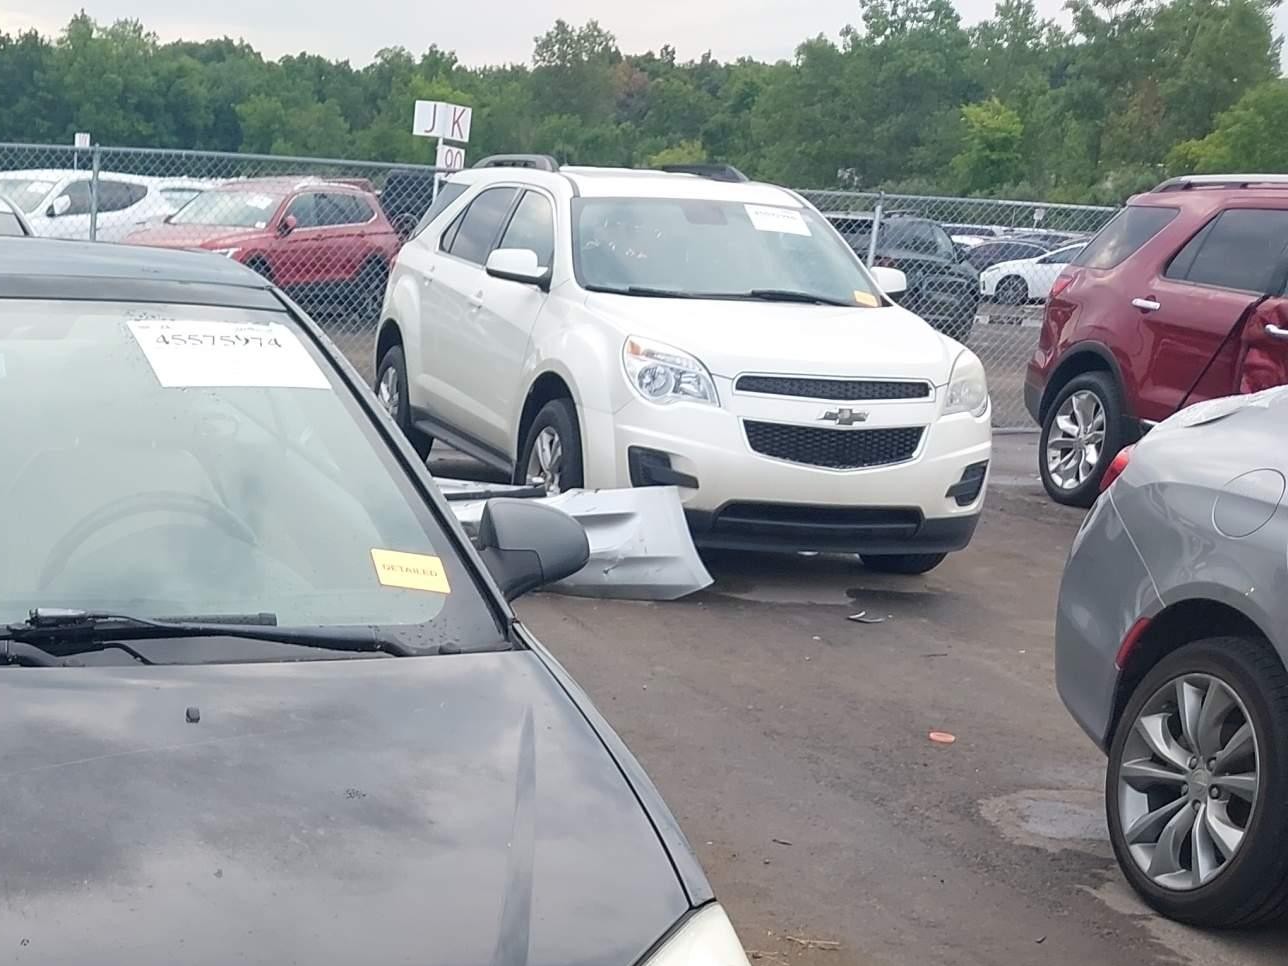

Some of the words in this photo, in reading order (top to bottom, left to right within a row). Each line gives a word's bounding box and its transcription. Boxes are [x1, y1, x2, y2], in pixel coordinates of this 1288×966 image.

[424, 103, 437, 133] J
[451, 106, 466, 139] K
[155, 333, 283, 349] 45575974
